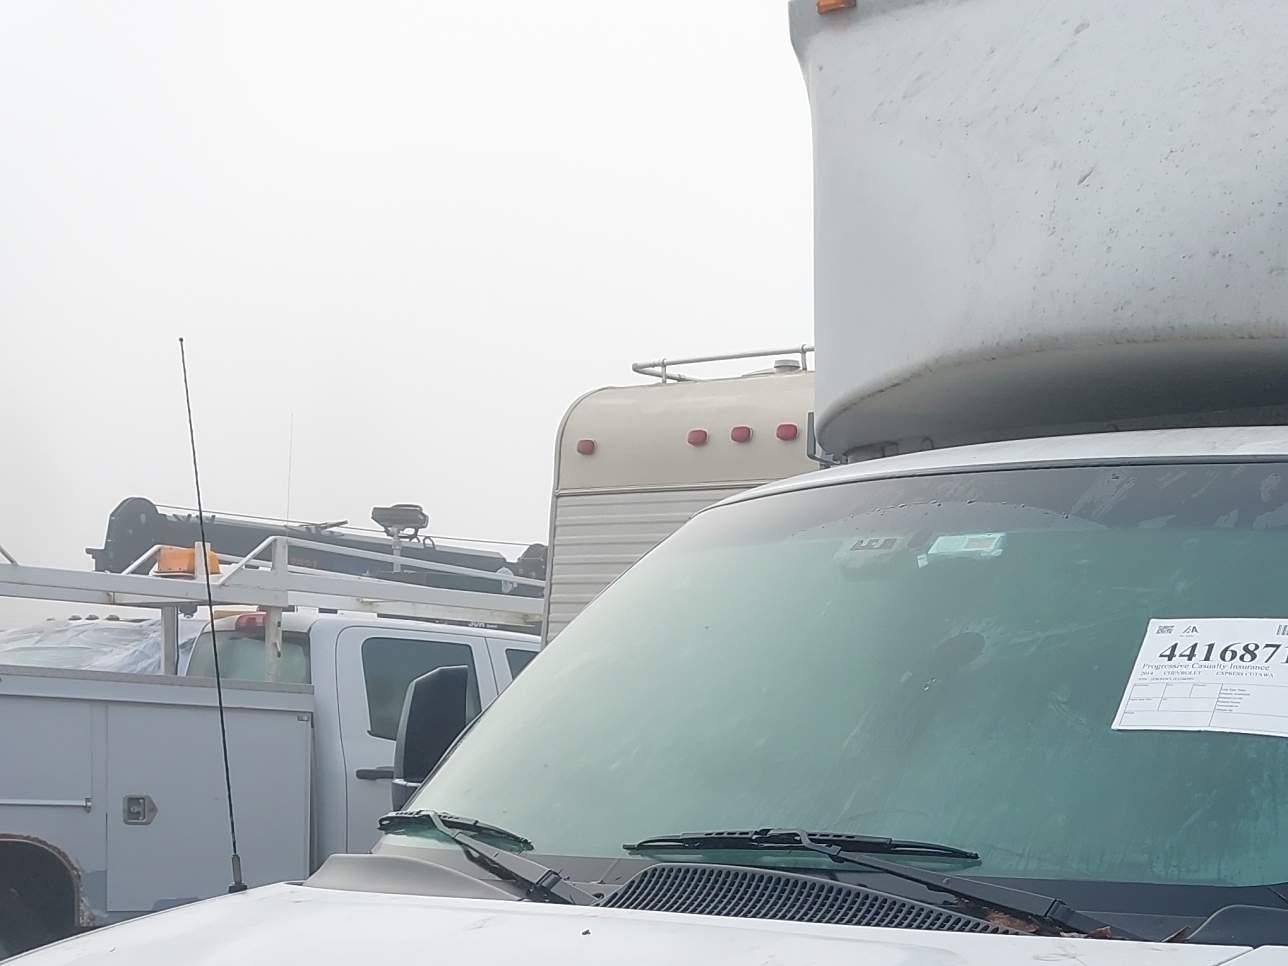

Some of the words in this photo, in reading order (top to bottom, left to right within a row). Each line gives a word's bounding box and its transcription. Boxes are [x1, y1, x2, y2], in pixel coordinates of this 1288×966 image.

[1142, 663, 1191, 671] Progressive
[1192, 663, 1227, 671] Casualty
[1229, 663, 1270, 671] Insurance
